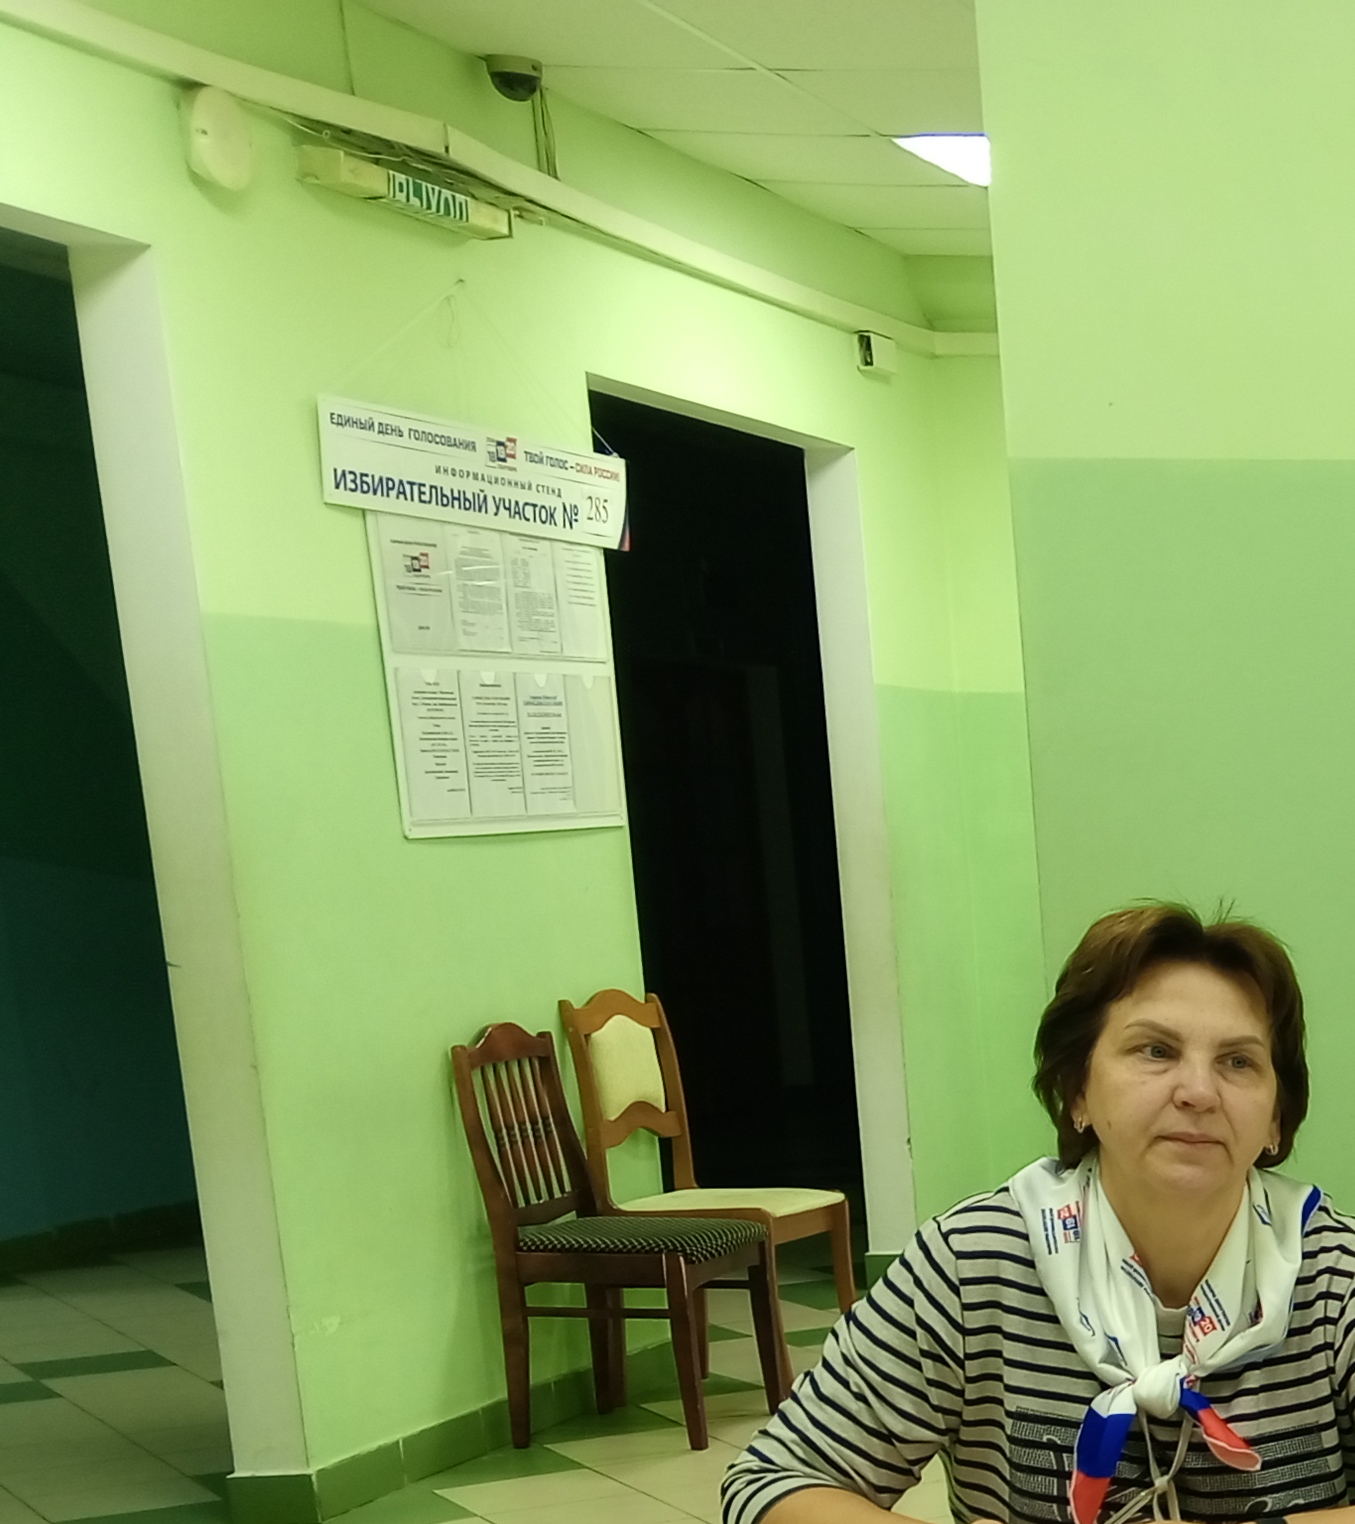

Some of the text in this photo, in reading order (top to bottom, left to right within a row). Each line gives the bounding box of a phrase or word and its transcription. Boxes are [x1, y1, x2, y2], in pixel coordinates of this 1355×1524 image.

[329, 412, 477, 452] ЕДИНЫЙ ДЕНЬ ГОЛОСОВАНИЯ
[523, 450, 544, 465] ТВОЙ
[333, 467, 489, 515] ИЗБИРАТЕЛЬНЫЙ
[492, 495, 558, 527] УЧАСТОК
[586, 495, 609, 524] 285
[435, 464, 562, 498] ИНФОРМАЦИОННЫЙ СТЕНД
